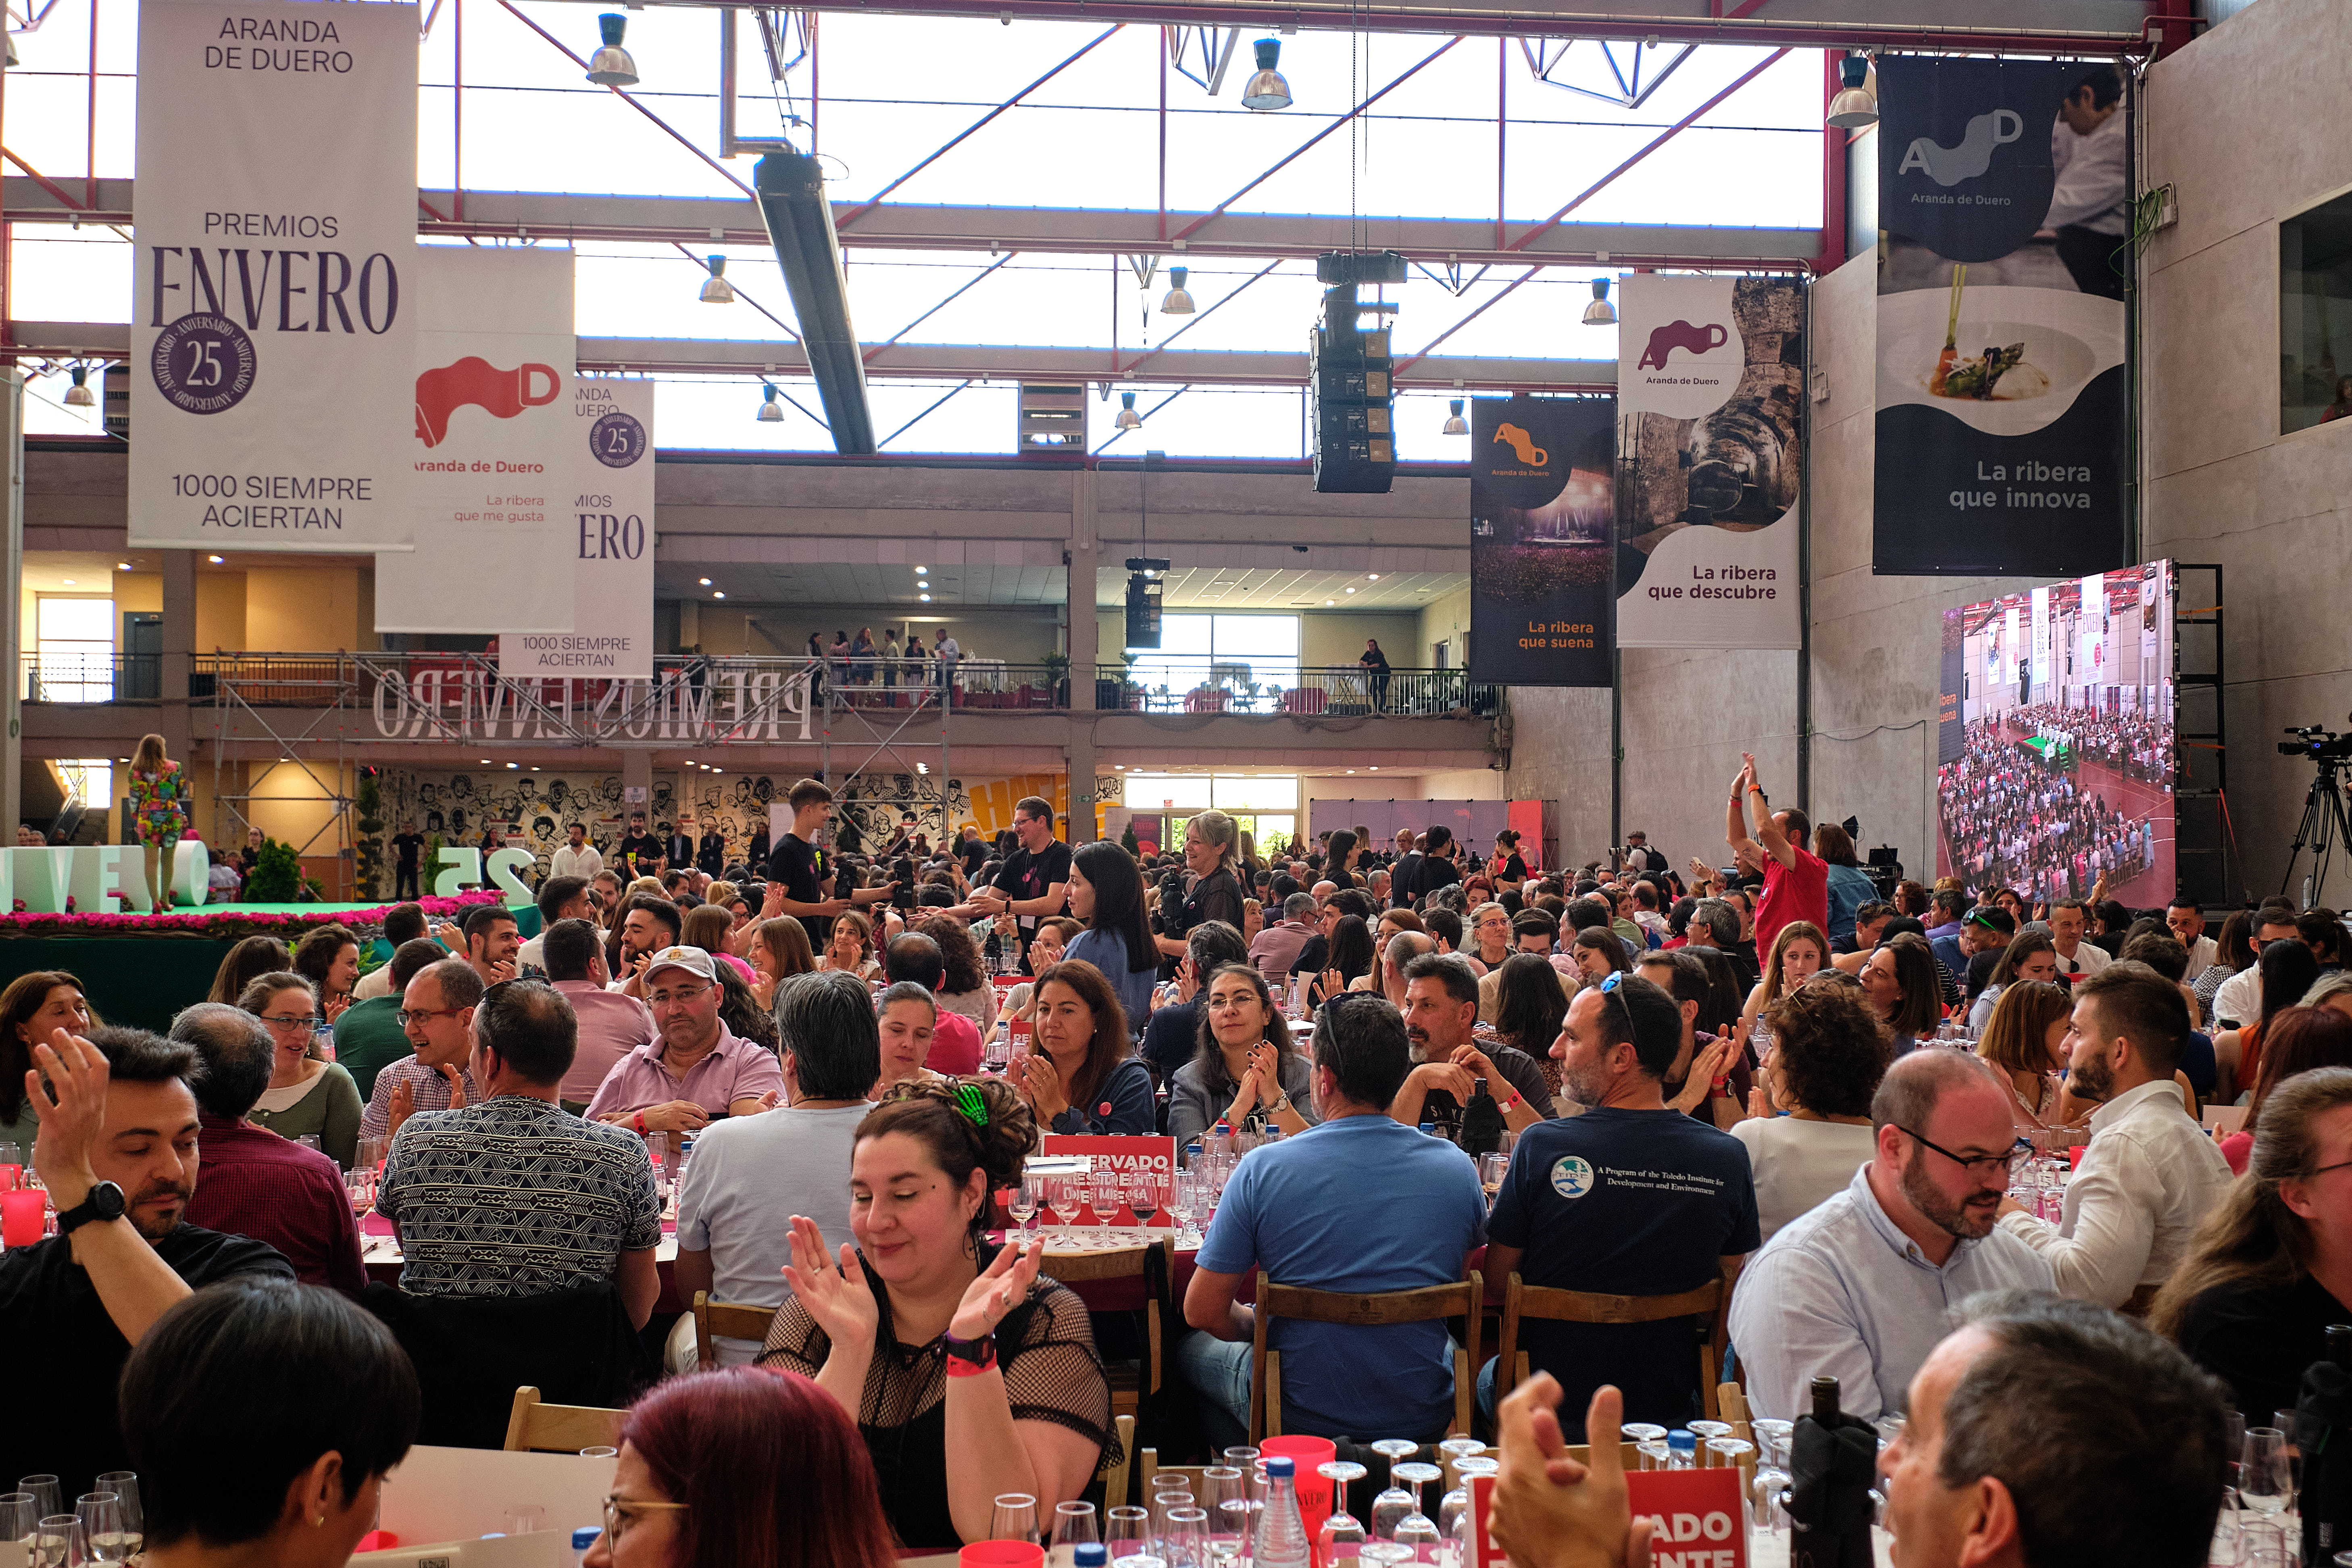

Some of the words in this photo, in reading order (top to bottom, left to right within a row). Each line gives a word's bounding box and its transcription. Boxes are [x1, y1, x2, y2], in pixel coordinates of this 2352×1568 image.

[219, 18, 340, 43] ARANDA
[206, 46, 242, 69] DE
[253, 48, 354, 73] DUERO
[1911, 193, 1954, 204] Aranda
[1957, 194, 1972, 204] de
[1976, 195, 2011, 206] Duero
[205, 212, 339, 238] PREMIOS
[151, 246, 399, 335] ENVERO
[177, 317, 234, 336] ANIVERSARIO
[186, 340, 222, 386] 25
[1680, 377, 1691, 385] de
[576, 404, 619, 416] UERO
[608, 428, 627, 453] 25
[471, 460, 491, 472] de
[496, 461, 544, 473] Duero
[1977, 460, 2006, 481] La
[2016, 461, 2091, 482] ribera
[173, 474, 237, 498] 1000
[246, 476, 373, 500] SIEMPRE
[487, 495, 502, 505] La
[506, 495, 544, 506] ribera
[1950, 490, 1997, 510] que
[2007, 487, 2091, 508] innova
[202, 505, 342, 529] ACIERTAN
[454, 512, 479, 522] que
[484, 512, 504, 521] me
[508, 512, 544, 523] gusta
[577, 514, 644, 559] ERO
[1693, 565, 1714, 579] La
[1721, 566, 1776, 580] ribera
[1648, 587, 1683, 602] que
[1689, 584, 1776, 600] descubre
[1529, 621, 1546, 633] La
[1551, 621, 1594, 633] ribera
[2083, 612, 2102, 634] ENVERO
[523, 637, 558, 649] 1000
[562, 637, 630, 650] SIEMPRE
[1519, 637, 1546, 649] que
[1551, 638, 1594, 648] suena
[538, 653, 614, 666] ACIERTAN
[1940, 693, 1956, 706] ibera
[1940, 710, 1956, 723] uena
[1050, 1154, 1168, 1168] ERVADO
[1605, 1167, 1636, 1177] Program
[1662, 1172, 1686, 1181] Toledo
[1687, 1174, 1715, 1185] Institute
[1607, 1178, 1654, 1188] Development
[1671, 1183, 1715, 1195] Environment
